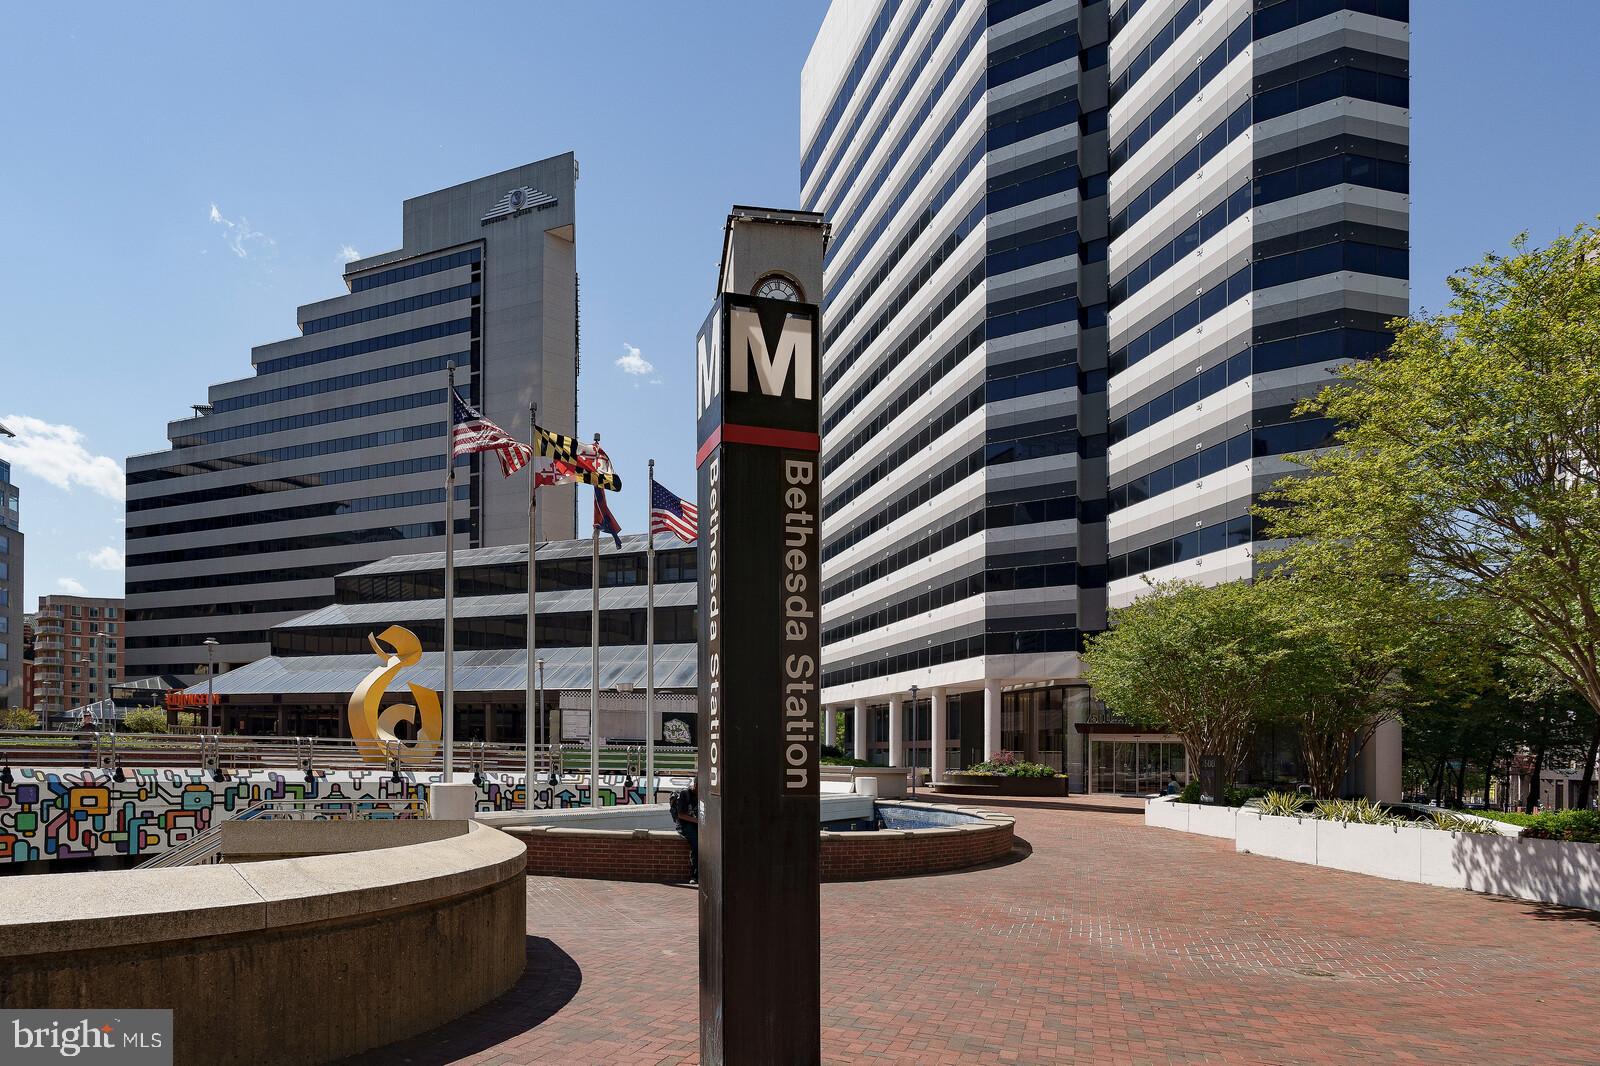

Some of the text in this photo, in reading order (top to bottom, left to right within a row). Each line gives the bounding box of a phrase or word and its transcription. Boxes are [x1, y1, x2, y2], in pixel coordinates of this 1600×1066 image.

[698, 307, 720, 421] M
[730, 304, 812, 400] M
[709, 457, 720, 787] Bethesda Station
[784, 459, 815, 789] Bethesda Station
